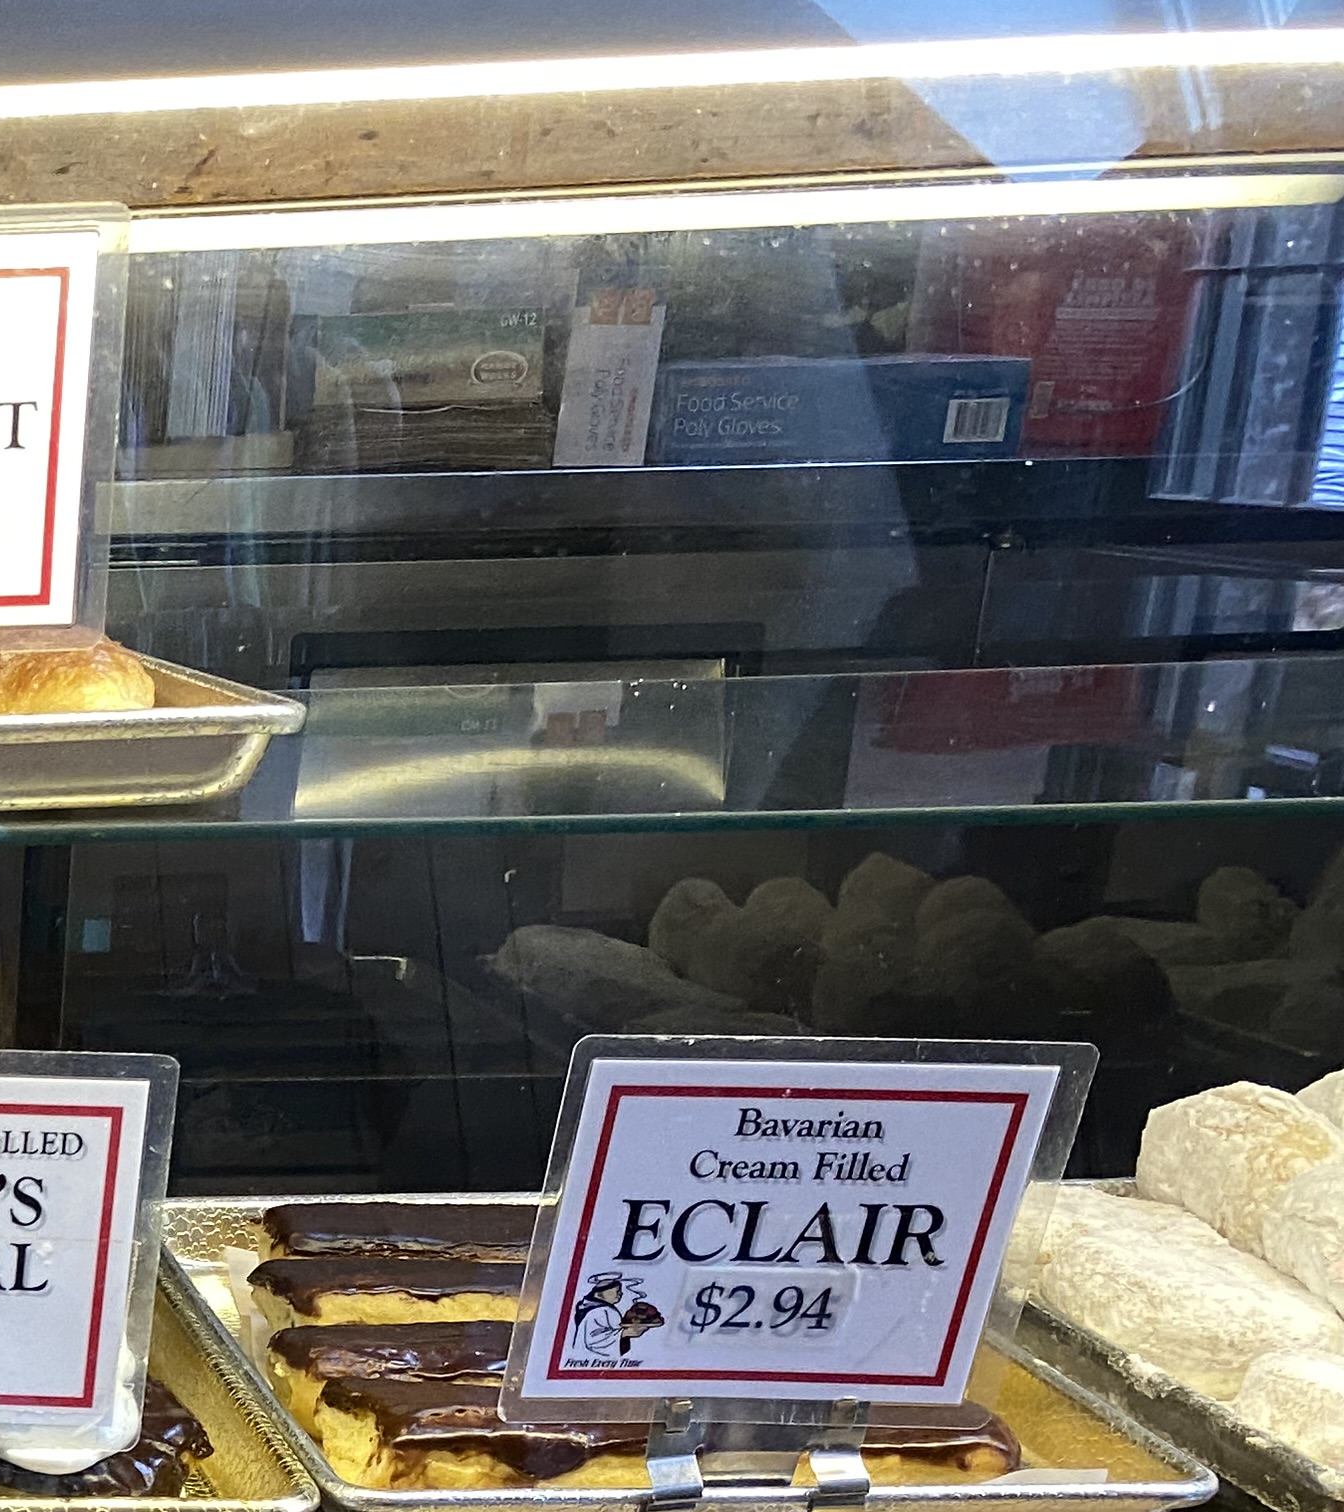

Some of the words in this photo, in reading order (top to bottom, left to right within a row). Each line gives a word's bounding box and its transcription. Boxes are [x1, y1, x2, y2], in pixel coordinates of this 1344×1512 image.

[676, 393, 725, 413] Food
[730, 391, 799, 412] Service
[673, 417, 711, 438] Poly
[717, 416, 782, 436] Gloves
[734, 1108, 883, 1141] Bavarian
[689, 1148, 799, 1182] Cream
[812, 1153, 909, 1182] Filled
[612, 1199, 945, 1266] ECLAIR
[689, 1281, 832, 1333] $2.94
